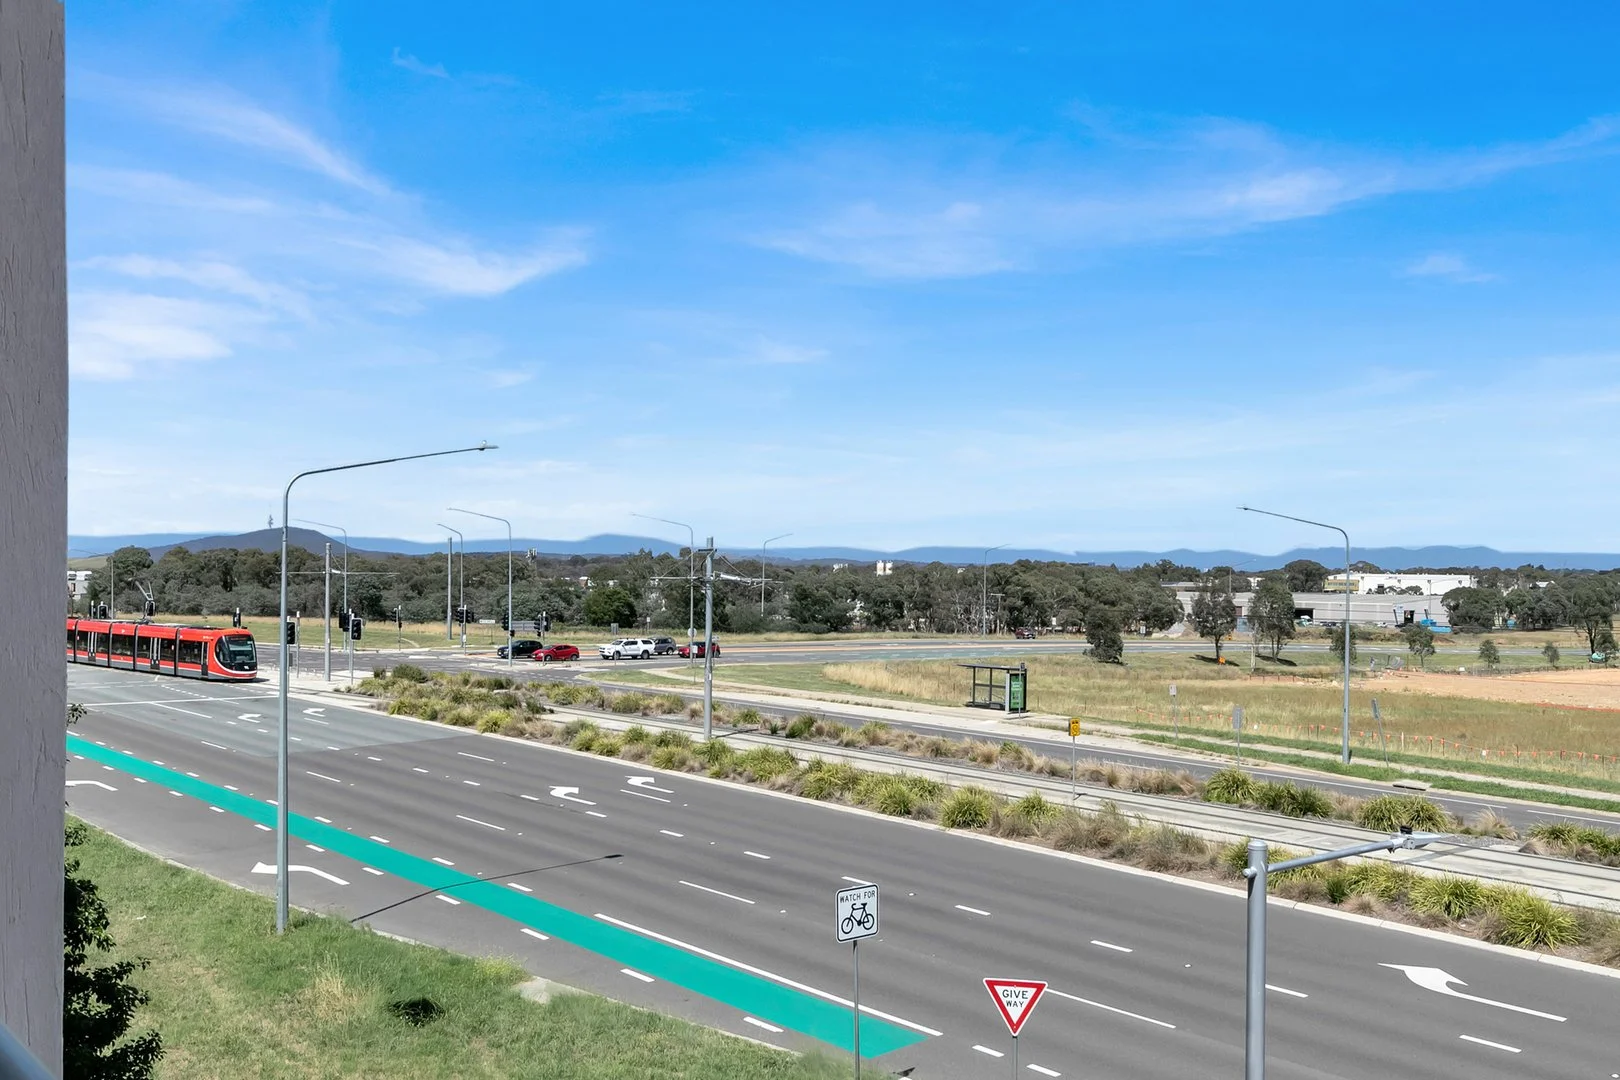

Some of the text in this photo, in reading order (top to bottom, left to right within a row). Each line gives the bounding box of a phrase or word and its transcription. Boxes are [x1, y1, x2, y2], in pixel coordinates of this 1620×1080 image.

[840, 890, 876, 903] WATCH FOR
[1002, 989, 1028, 999] GIVE
[1006, 1000, 1024, 1008] WAY
